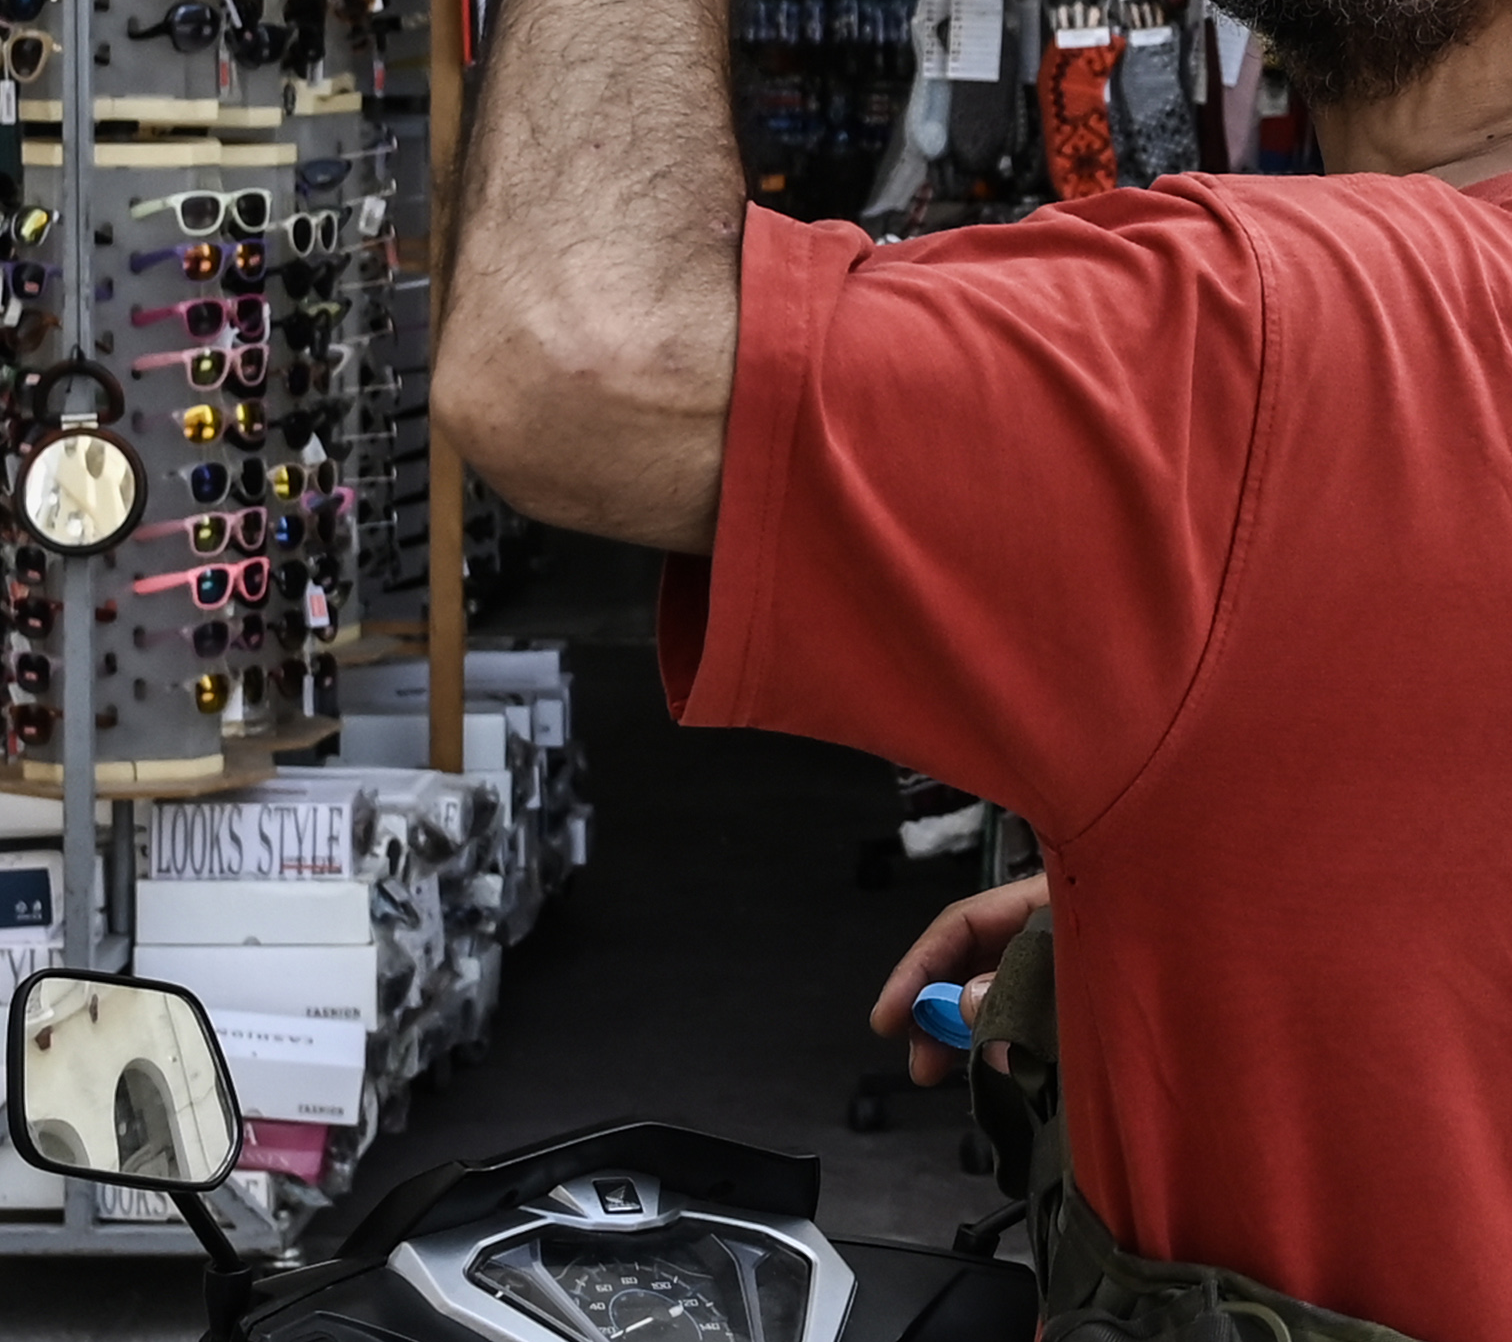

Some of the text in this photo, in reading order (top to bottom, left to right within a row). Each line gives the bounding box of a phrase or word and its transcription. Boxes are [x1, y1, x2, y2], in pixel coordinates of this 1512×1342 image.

[156, 803, 343, 875] LOOKS STYLE
[589, 1302, 606, 1311] 40
